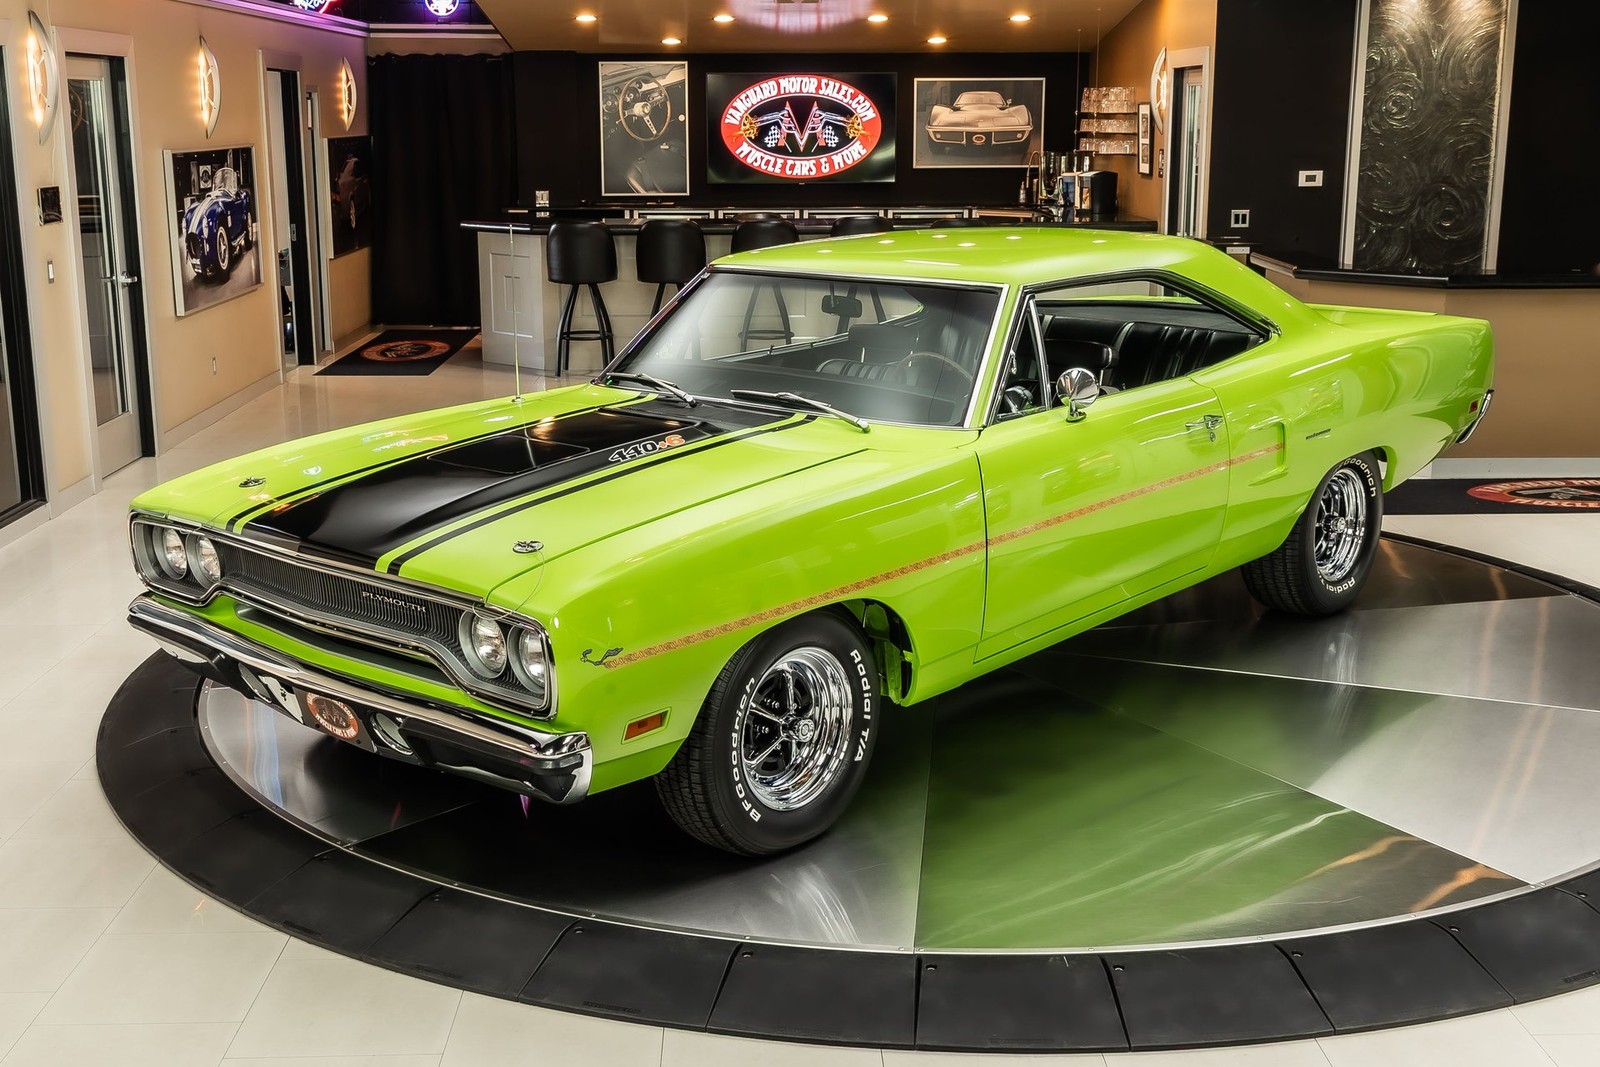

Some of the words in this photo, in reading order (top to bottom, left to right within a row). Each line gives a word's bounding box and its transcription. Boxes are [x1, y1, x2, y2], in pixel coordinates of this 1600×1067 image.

[725, 80, 778, 126] VANGUARD
[778, 77, 818, 95] MOTOR
[818, 78, 877, 122] SALES.COM
[735, 141, 787, 175] MUSCLE
[785, 158, 817, 176] CARS
[819, 157, 830, 174] &
[832, 140, 868, 171] MORE
[362, 591, 427, 613] PLYMOUTH
[1326, 576, 1356, 593] Radial
[850, 649, 871, 720] Radial
[731, 677, 762, 822] BFGoodrich
[854, 728, 870, 762] T/A
